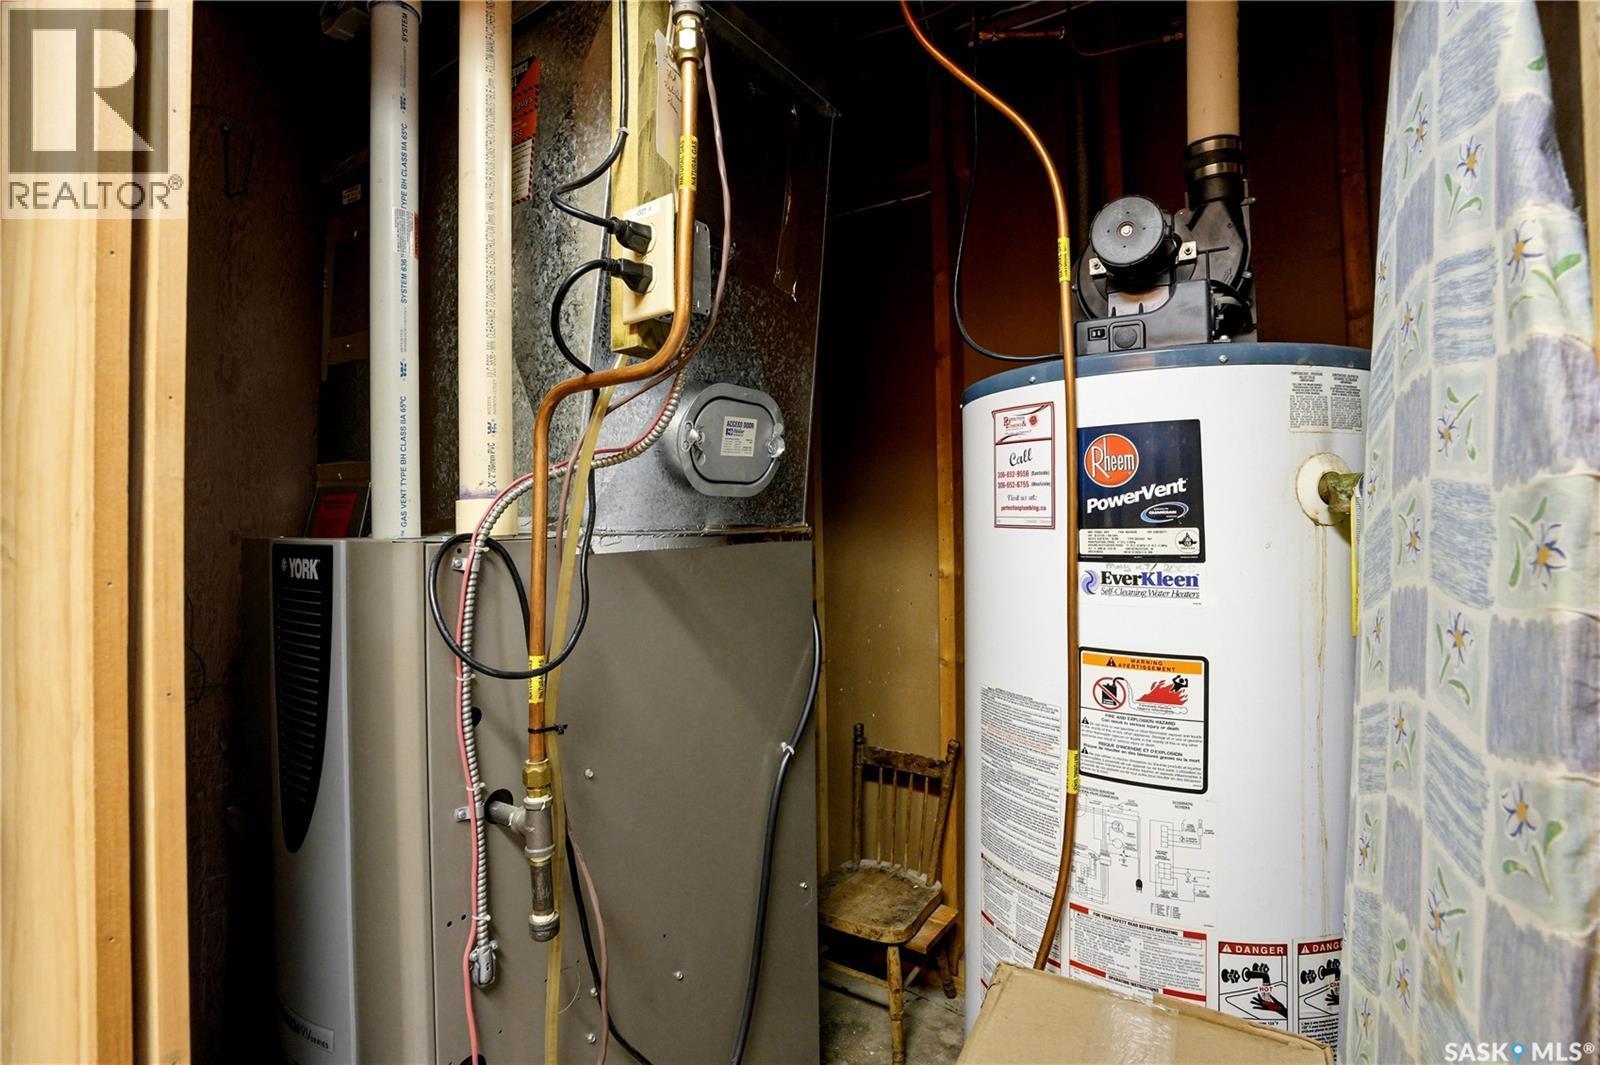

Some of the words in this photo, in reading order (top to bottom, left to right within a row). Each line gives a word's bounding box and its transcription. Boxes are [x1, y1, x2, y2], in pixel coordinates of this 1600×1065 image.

[400, 454, 406, 465] BH
[1009, 448, 1032, 466] Call
[1091, 437, 1135, 478] Rheem
[1087, 477, 1187, 514] PowerVent
[289, 558, 319, 580] YORK
[1100, 571, 1199, 587] EverKleen
[1101, 587, 1148, 598] Self-Cleaning
[1149, 589, 1170, 598] Water
[1171, 589, 1200, 599] Heaters
[1118, 663, 1175, 672] AVERTISSEMENT
[1235, 945, 1284, 955] DANGER
[1312, 942, 1339, 952] DANG
